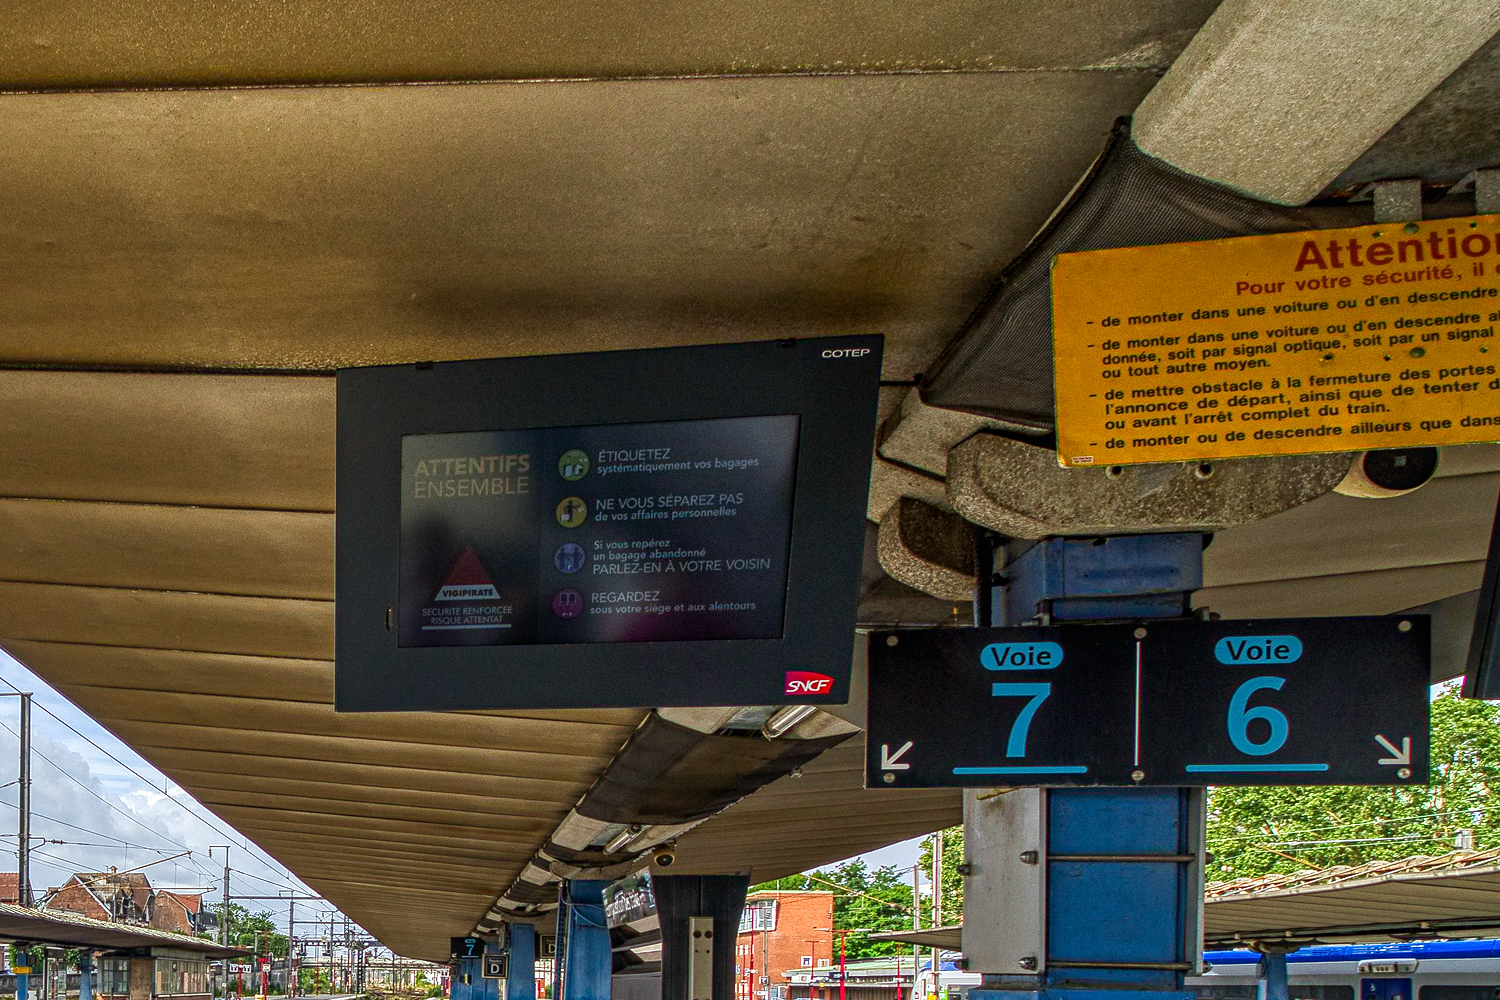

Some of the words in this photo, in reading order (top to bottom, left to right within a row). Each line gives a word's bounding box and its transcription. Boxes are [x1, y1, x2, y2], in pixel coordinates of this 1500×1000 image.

[1236, 278, 1285, 296] Pour
[1295, 276, 1352, 291] votre
[1362, 265, 1462, 287] sécurité,
[1472, 262, 1484, 276] il
[1101, 316, 1121, 328] de
[1127, 312, 1185, 326] monter
[1191, 308, 1230, 321] dans
[1237, 306, 1266, 317] une
[1273, 300, 1329, 314] voiture
[1337, 299, 1357, 310] ou
[1364, 295, 1400, 307] d'en
[1407, 287, 1499, 304] descendre
[1102, 340, 1120, 351] de
[1127, 336, 1181, 349] monter
[1187, 332, 1225, 344] dans
[1231, 329, 1259, 341] une
[1266, 324, 1319, 338] voiture
[1326, 323, 1346, 334] ou
[1353, 320, 1387, 332] d'en
[1394, 312, 1481, 329] descendre
[821, 348, 871, 359] COTEP
[1102, 351, 1162, 365] donnée,
[1167, 348, 1196, 361] soit
[1202, 346, 1227, 360] par
[1233, 342, 1277, 357] signal
[1283, 338, 1347, 354] optique,
[1353, 335, 1382, 348] soit
[1388, 332, 1415, 347] par
[1421, 331, 1440, 342] un
[1447, 326, 1494, 342] signal
[1101, 369, 1121, 379] ou
[1128, 365, 1159, 377] tout
[1166, 362, 1206, 374] autre
[1214, 358, 1271, 372] moyen.
[1104, 389, 1124, 401] de
[1131, 385, 1185, 398] mettre
[1191, 379, 1263, 395] obstacle
[1271, 377, 1280, 389] à
[1287, 376, 1301, 388] la
[1309, 371, 1391, 387] fermeture
[1399, 368, 1431, 381] des
[1439, 364, 1496, 380] portes
[1105, 400, 1189, 415] l'annonce
[1197, 397, 1219, 409] de
[1227, 392, 1291, 408] départ,
[1299, 388, 1341, 403] ainsi
[1349, 387, 1383, 401] que
[1391, 384, 1415, 397] de
[1423, 379, 1480, 395] tenter
[1104, 420, 1125, 430] ou
[1132, 414, 1177, 428] avant
[1184, 410, 1233, 425] l'arrêt
[1241, 404, 1310, 421] complet
[1318, 404, 1339, 417] du
[1347, 402, 1390, 414] train.
[1104, 437, 1125, 450] de
[1132, 434, 1190, 447] monter
[1197, 433, 1218, 444] ou
[1225, 430, 1246, 441] de
[1253, 423, 1343, 440] descendre
[1350, 420, 1412, 435] ailleurs
[1420, 418, 1452, 432] que
[1460, 415, 1500, 427] dans
[413, 454, 530, 477] ATTENTIFS
[598, 448, 671, 463] ÉTIQUETEZ
[597, 461, 691, 476] systématiquement
[694, 460, 712, 469] vos
[714, 457, 759, 471] bagages
[414, 476, 530, 499] ENSEMBLE
[595, 498, 615, 510] NE
[618, 497, 655, 509] VOUS
[658, 493, 715, 507] SÉPAREZ
[718, 493, 744, 505] PAS
[595, 511, 608, 522] de
[611, 512, 628, 521] vos
[631, 509, 669, 520] affaires
[671, 507, 737, 521] personnelles
[593, 540, 603, 550] Si
[605, 541, 629, 549] vous
[631, 539, 671, 550] repérez
[593, 553, 606, 561] un
[608, 550, 646, 562] bagage
[649, 548, 706, 559] abandonné
[593, 562, 661, 575] PARLEZ-EN
[665, 560, 676, 572] À
[679, 560, 722, 572] VOTRE
[725, 558, 771, 570] VOISIN
[441, 588, 494, 598] VIGIPIRATE
[591, 590, 661, 603] REGARDEZ
[590, 606, 613, 615] sous
[615, 604, 642, 614] votre
[644, 603, 671, 615] siège
[674, 603, 685, 612] et
[687, 603, 706, 611] aux
[708, 601, 756, 611] alentours
[430, 616, 462, 625] RISQUE
[463, 615, 503, 625] ATTENTAT
[989, 646, 1052, 667] Voie
[1224, 639, 1290, 661] Voie
[786, 679, 830, 693] SNCF
[991, 681, 1052, 758] 7
[1226, 675, 1290, 756] 6
[466, 944, 475, 956] 7
[490, 963, 500, 974] D
